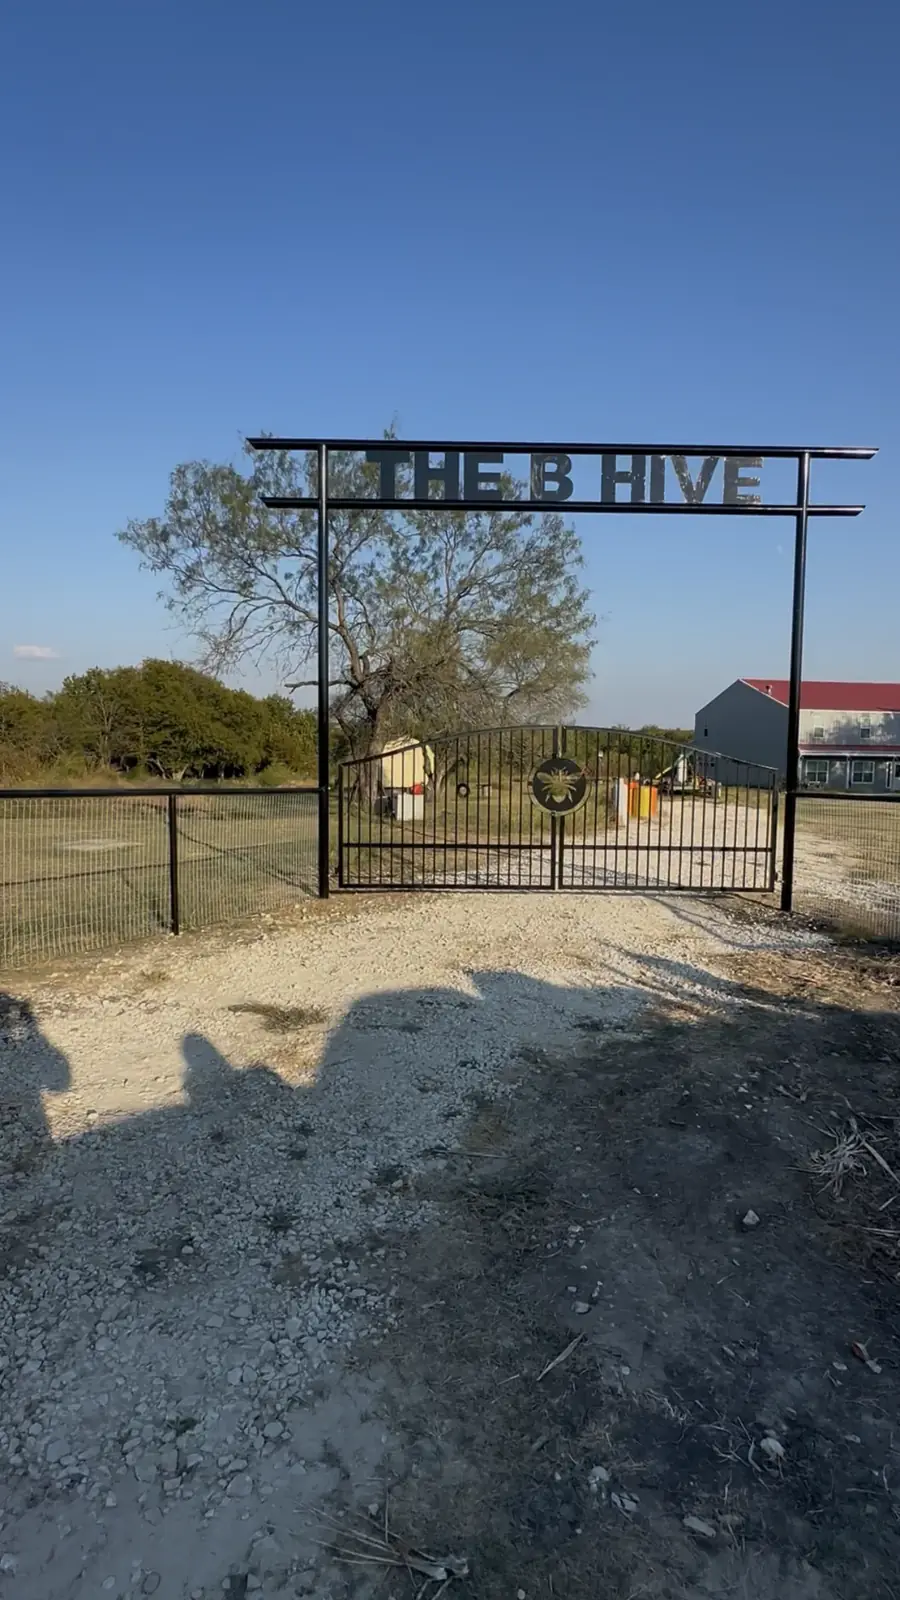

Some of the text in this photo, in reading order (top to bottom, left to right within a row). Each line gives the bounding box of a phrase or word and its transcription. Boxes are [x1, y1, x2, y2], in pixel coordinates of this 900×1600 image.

[366, 450, 764, 505] THE B HIVE
